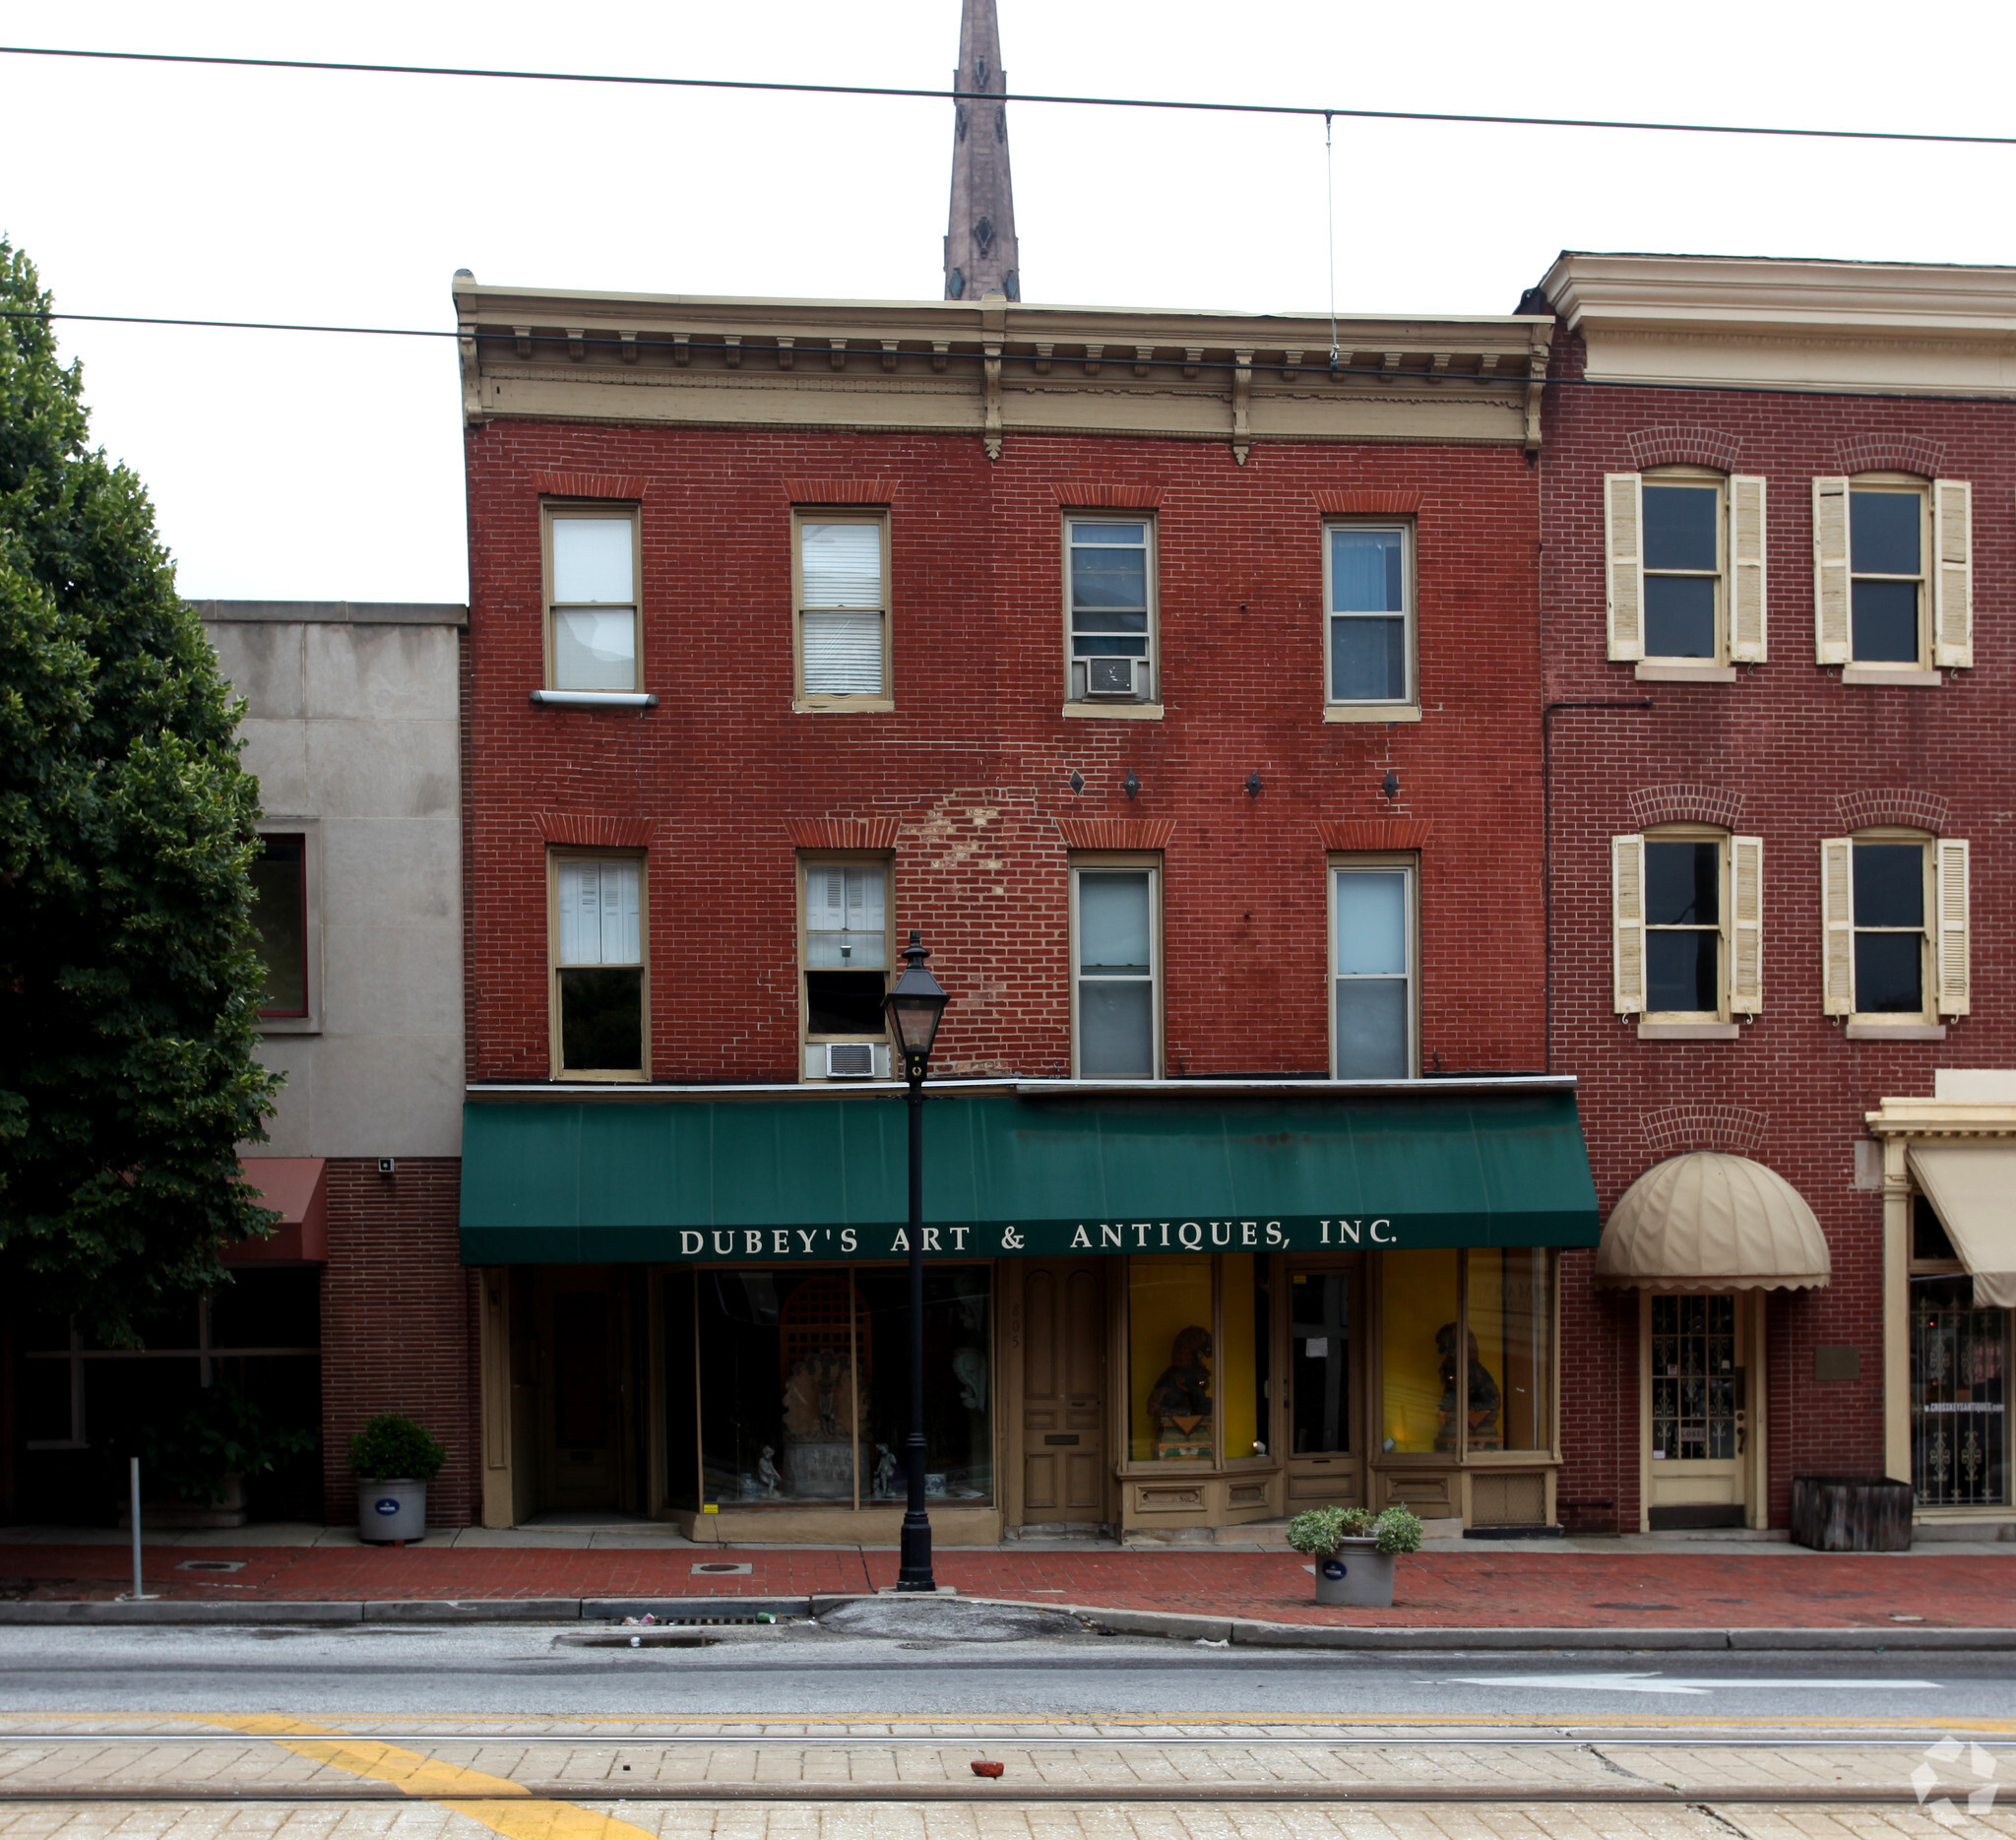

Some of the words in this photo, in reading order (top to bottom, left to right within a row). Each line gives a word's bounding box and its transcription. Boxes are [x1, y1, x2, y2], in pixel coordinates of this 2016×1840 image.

[679, 1228, 858, 1254] DUBEY'S
[890, 1227, 971, 1251] ART
[1001, 1226, 1025, 1249] &
[1070, 1221, 1291, 1251] ANTIQUES,
[1320, 1219, 1397, 1244] INC.
